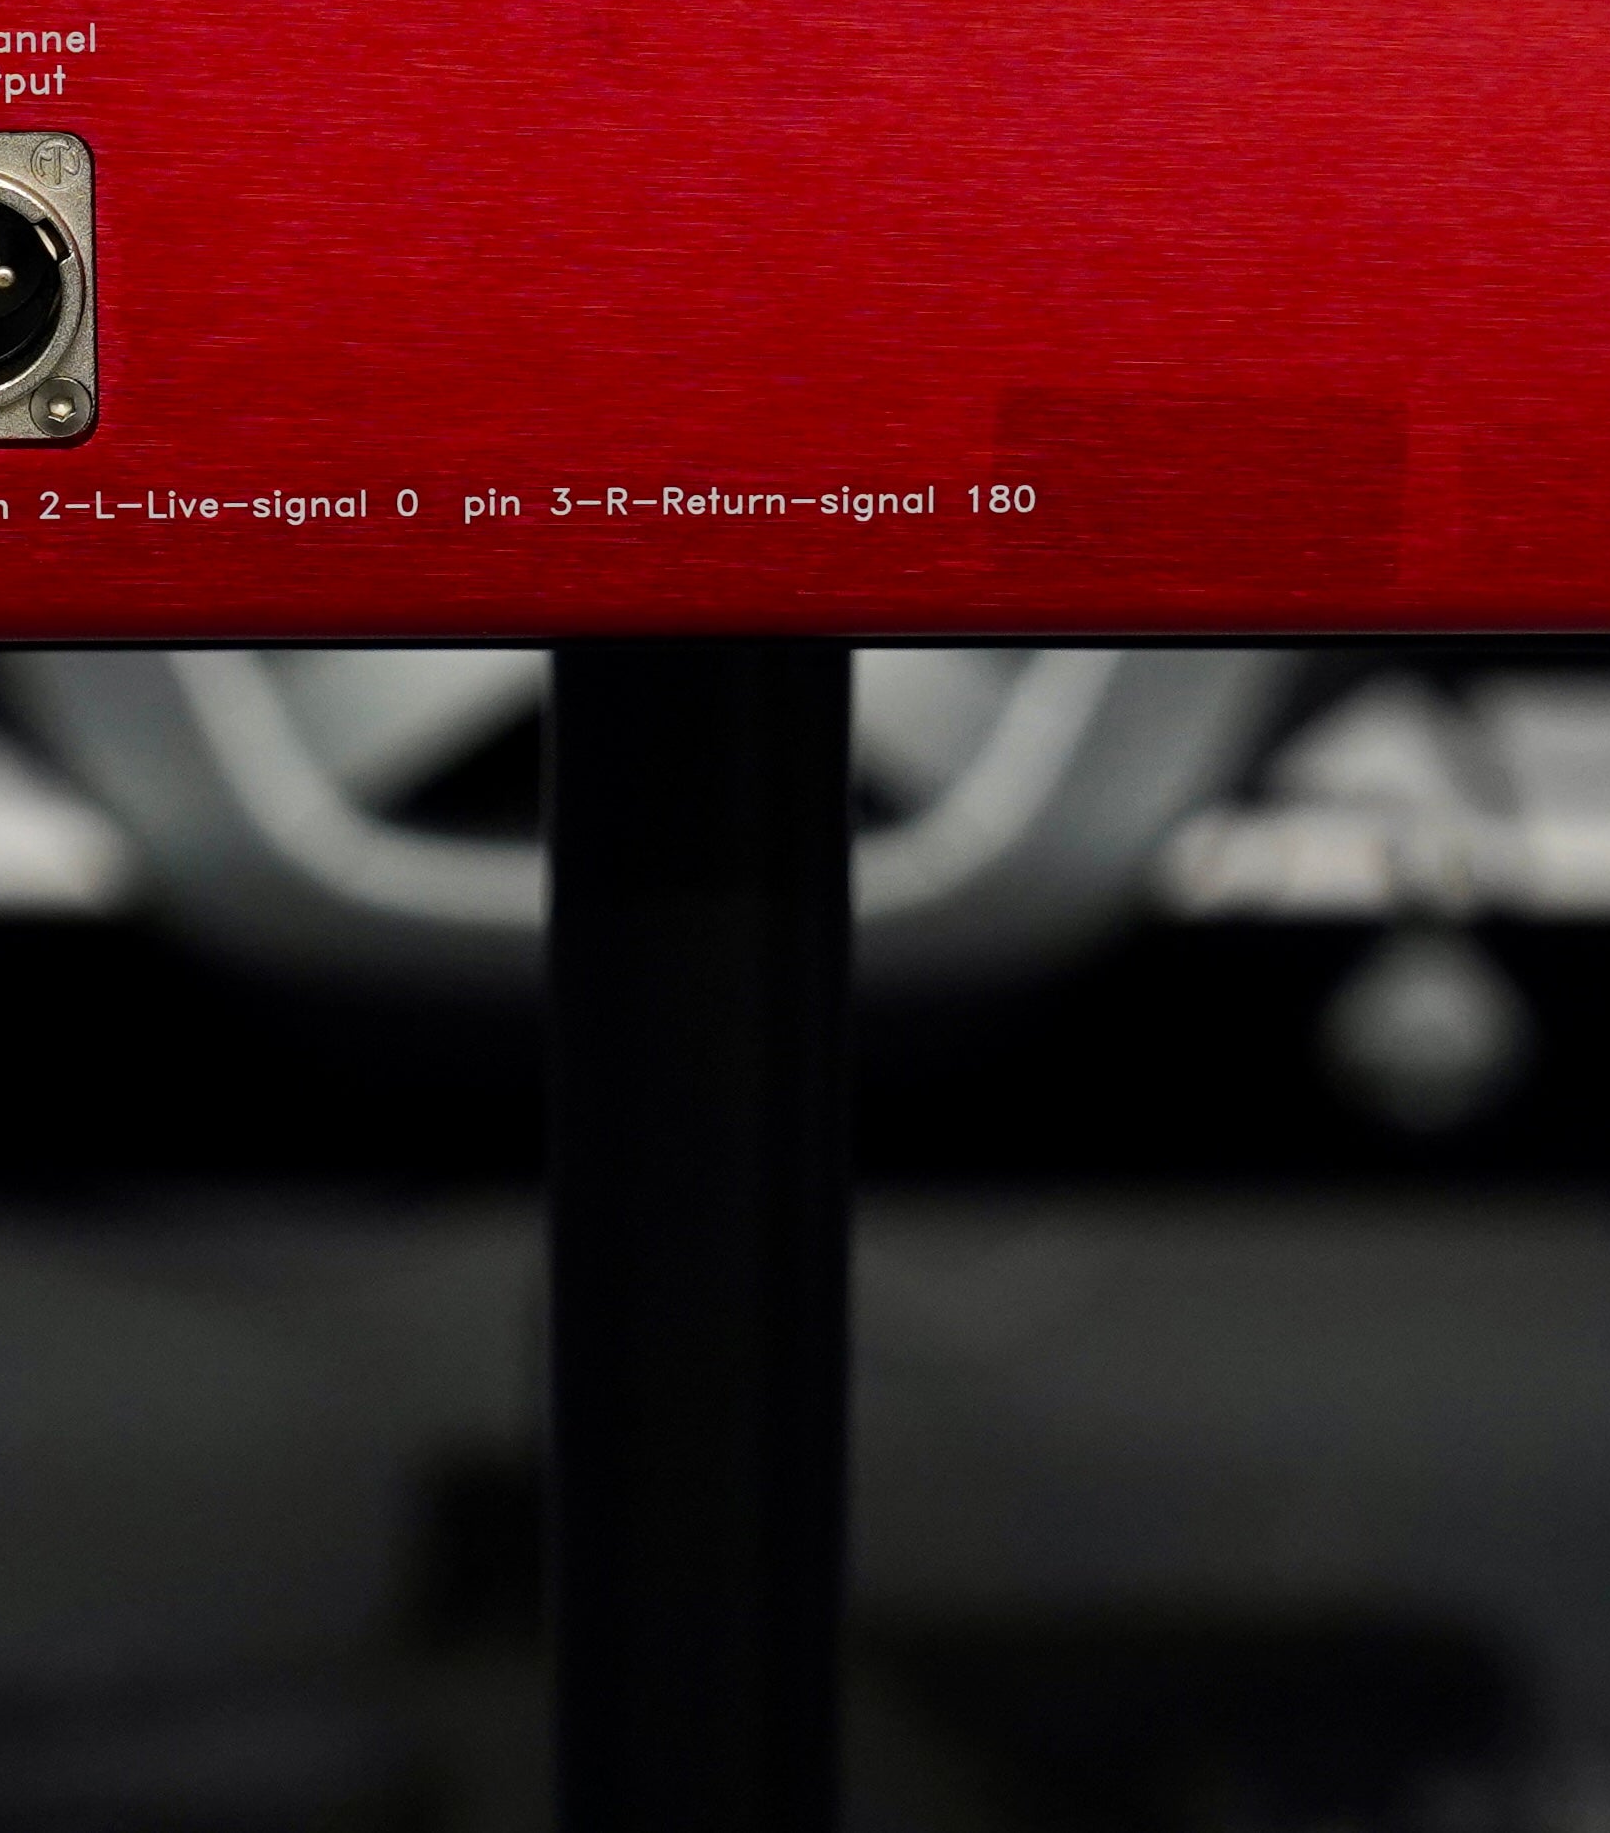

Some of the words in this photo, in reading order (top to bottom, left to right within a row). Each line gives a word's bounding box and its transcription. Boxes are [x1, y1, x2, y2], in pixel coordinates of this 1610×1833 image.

[39, 489, 367, 526] 2-L-Live-signal
[396, 488, 419, 517] 0
[464, 487, 521, 525] pin
[550, 485, 934, 522] 3-R-Return-signal
[968, 484, 1036, 514] 180
